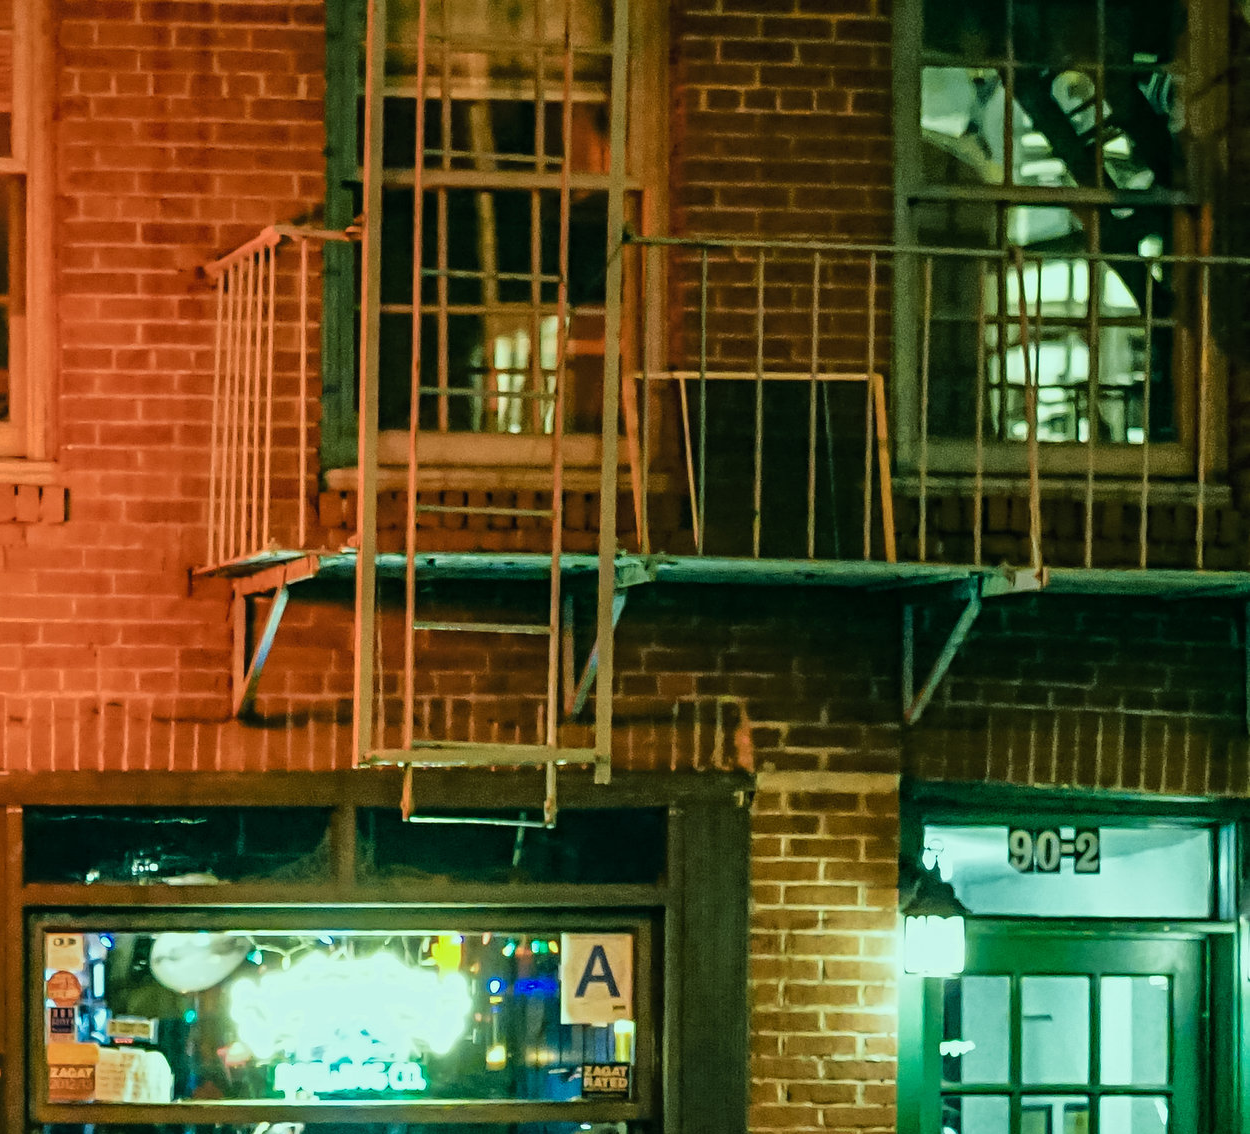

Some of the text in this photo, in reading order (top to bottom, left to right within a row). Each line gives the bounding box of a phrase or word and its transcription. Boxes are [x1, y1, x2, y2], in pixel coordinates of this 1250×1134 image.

[1009, 829, 1099, 872] 90-2
[575, 945, 621, 998] A
[50, 1066, 94, 1078] ZAGAT
[583, 1066, 628, 1077] ZAGAT
[583, 1077, 628, 1088] RATED
